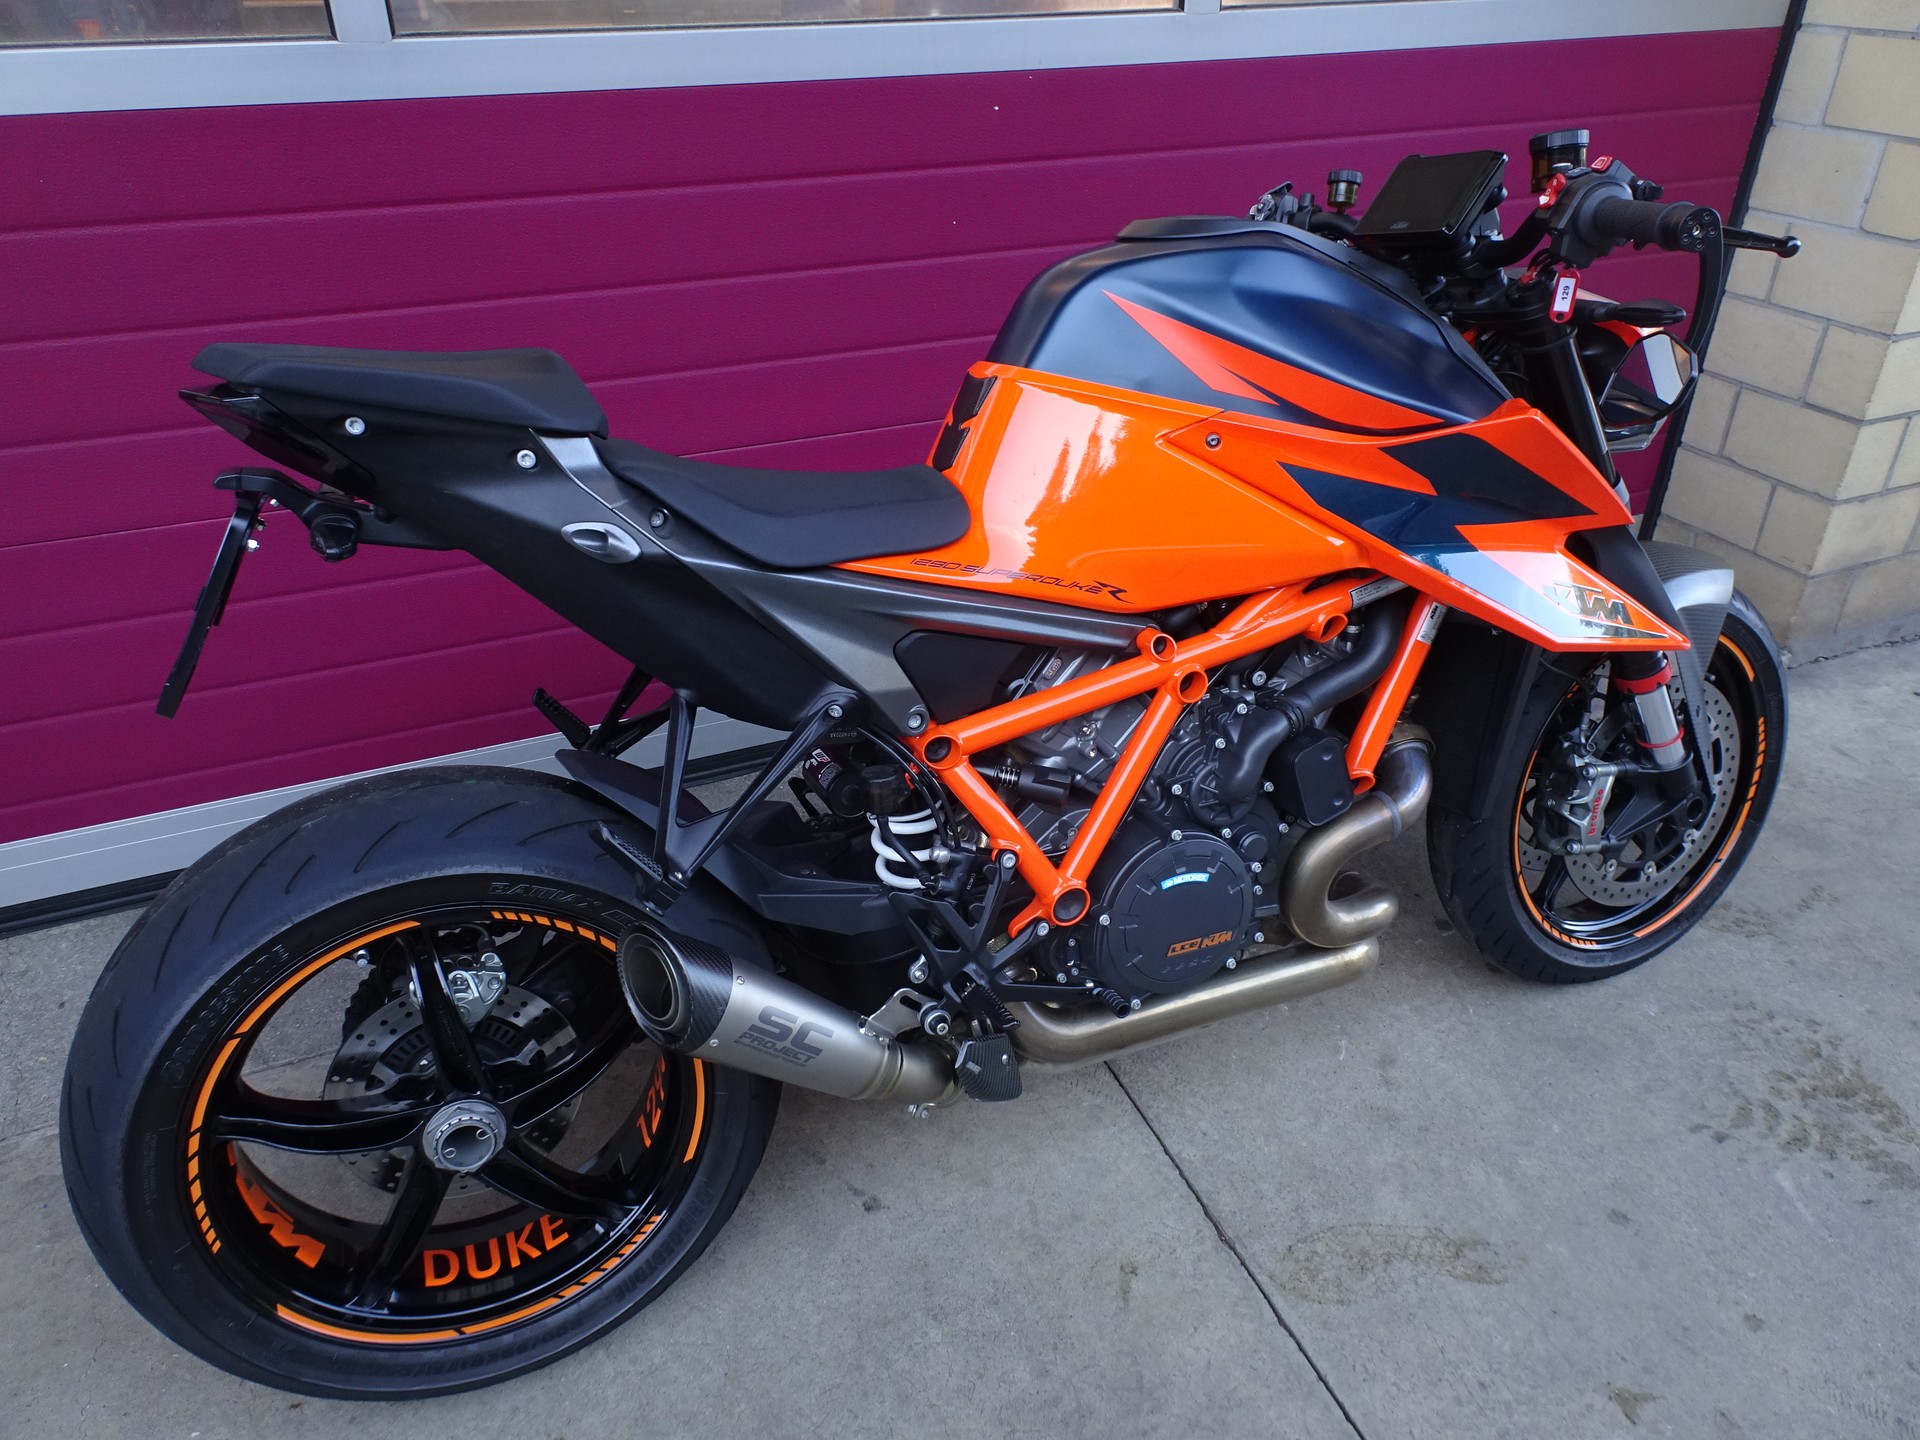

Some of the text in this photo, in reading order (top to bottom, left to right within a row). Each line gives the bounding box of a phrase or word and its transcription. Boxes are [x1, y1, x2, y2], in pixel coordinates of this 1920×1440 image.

[1561, 285, 1570, 301] 129
[910, 558, 961, 570] 1290
[1430, 605, 1439, 620] KTM
[1542, 582, 1634, 626] KTM
[1588, 789, 1604, 836] brembo
[1201, 931, 1233, 948] KTM
[737, 1031, 817, 1064] PROJECT
[746, 1005, 835, 1057] SC
[423, 1213, 570, 1287] DUKE
